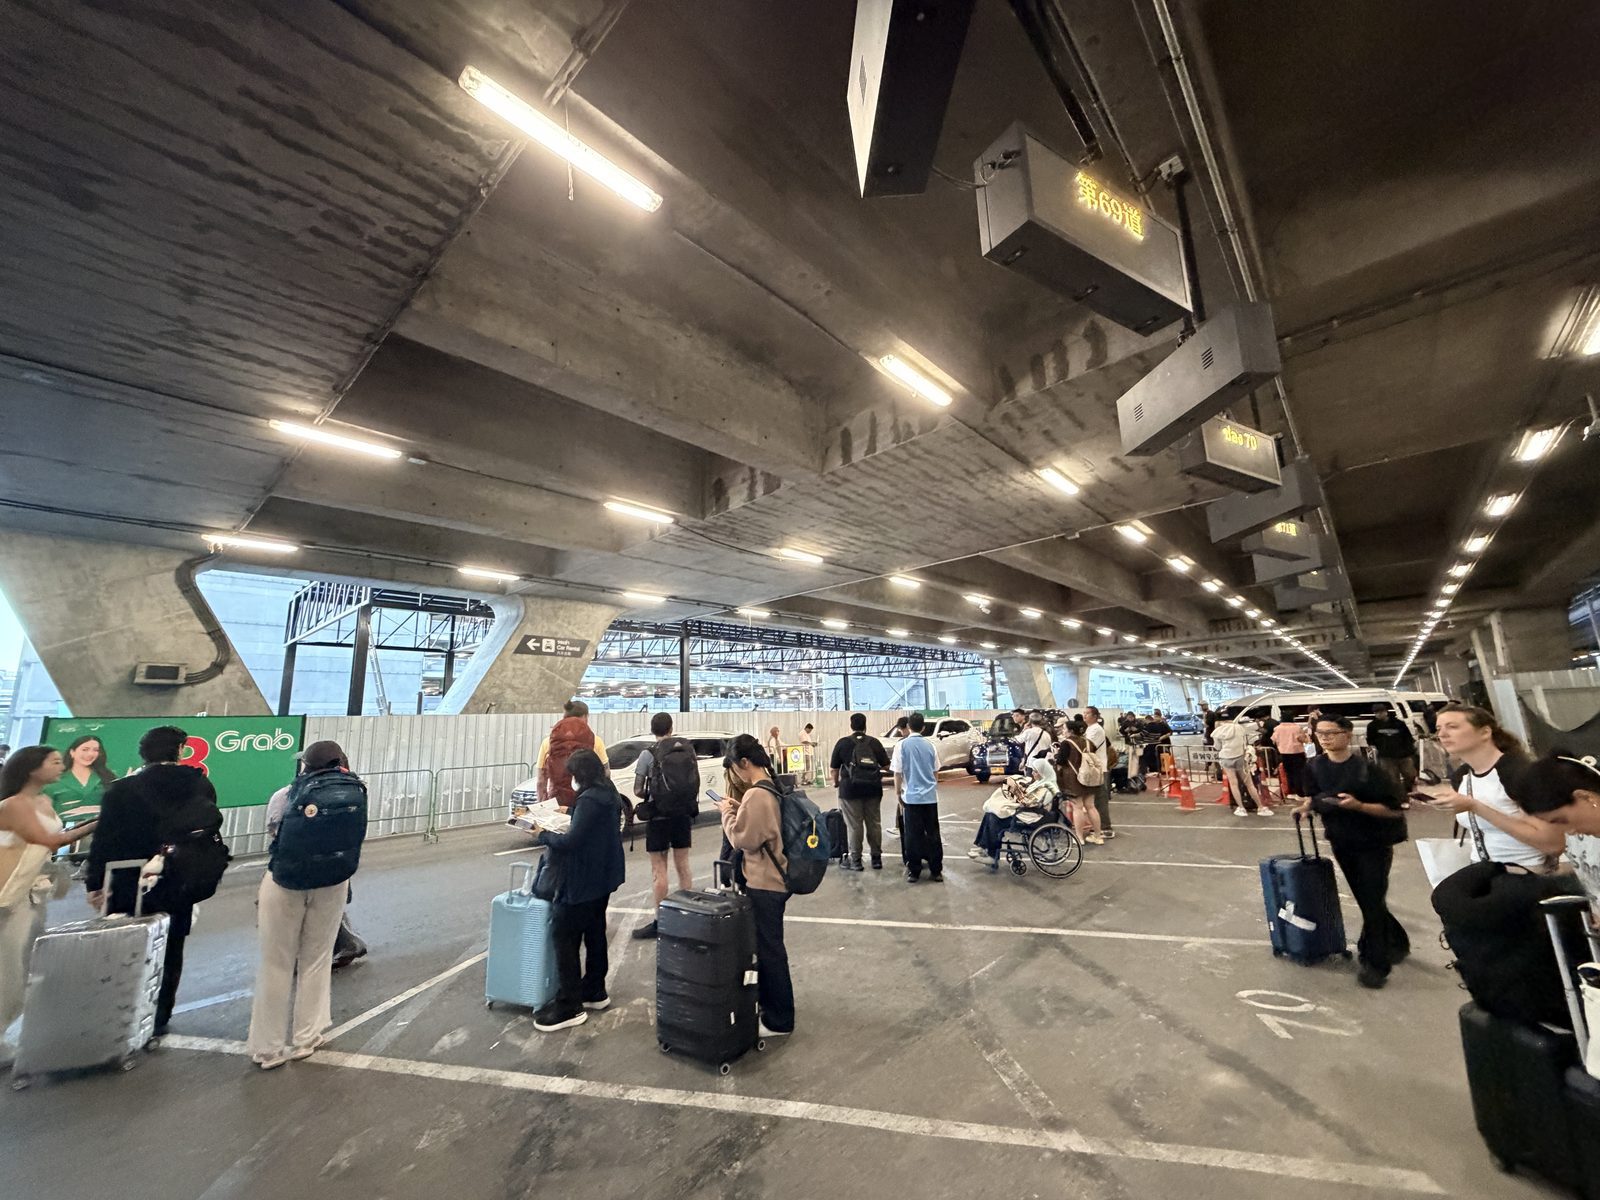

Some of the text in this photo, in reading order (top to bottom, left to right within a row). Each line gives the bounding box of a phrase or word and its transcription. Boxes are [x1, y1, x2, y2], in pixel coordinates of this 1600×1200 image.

[1075, 171, 1144, 241] 第69道
[1244, 432, 1258, 451] 70
[214, 728, 295, 753] Grab
